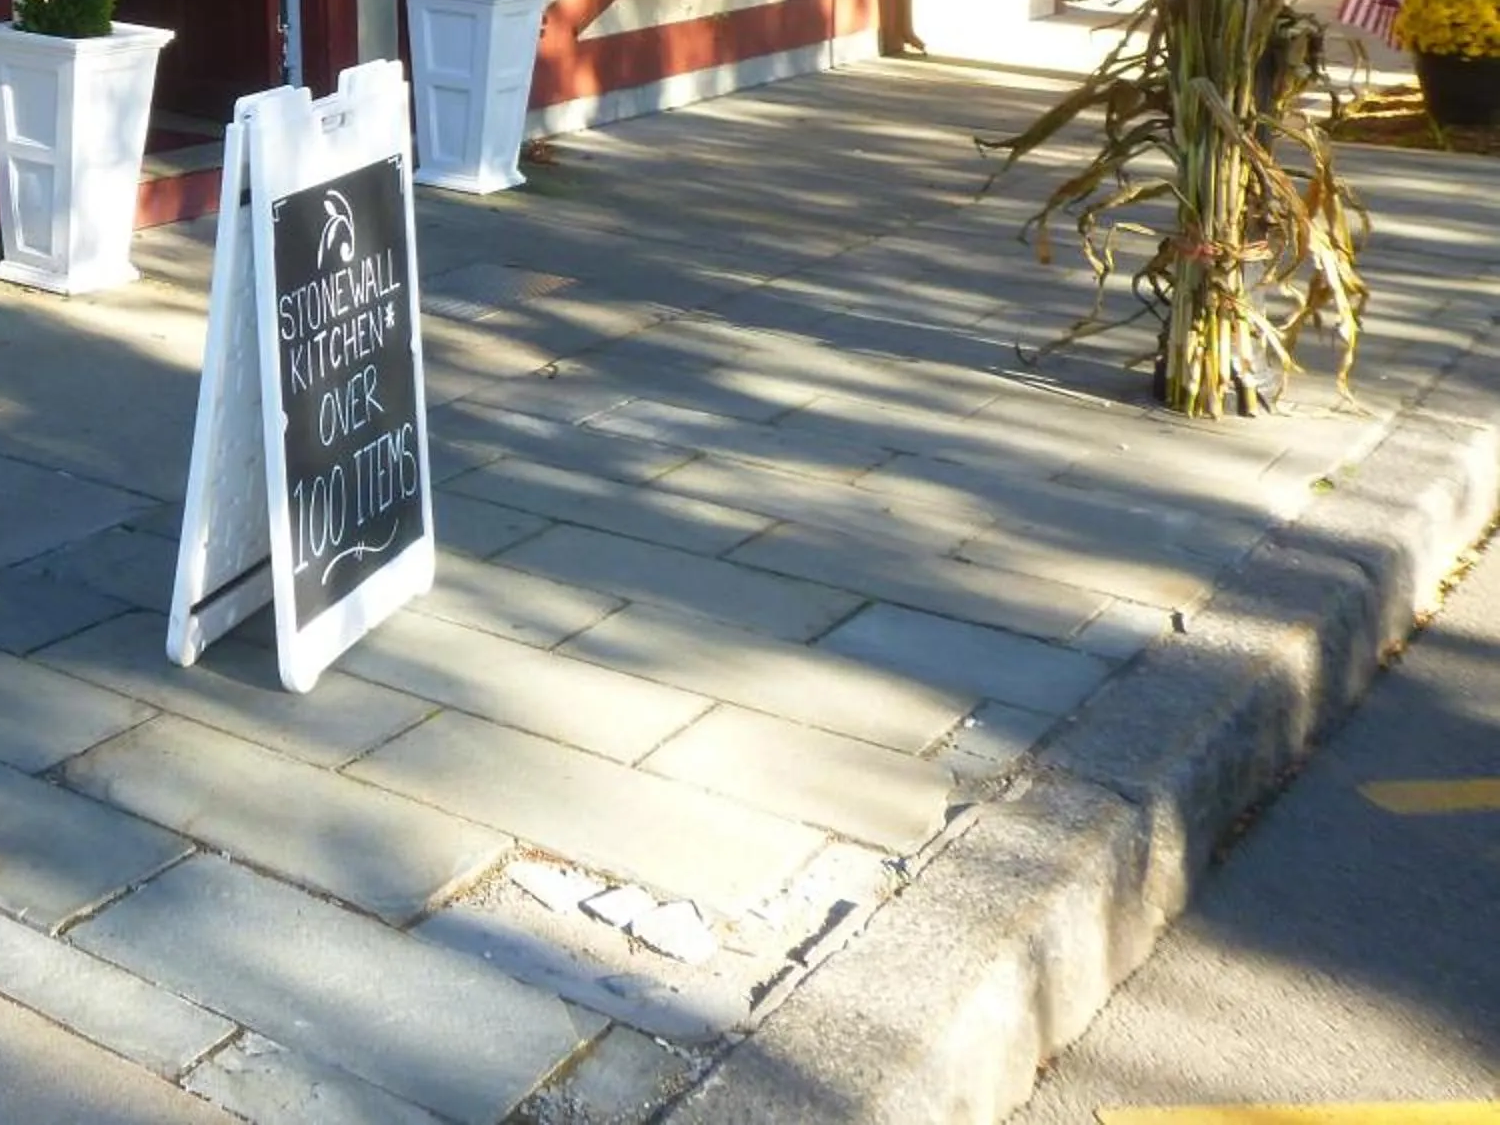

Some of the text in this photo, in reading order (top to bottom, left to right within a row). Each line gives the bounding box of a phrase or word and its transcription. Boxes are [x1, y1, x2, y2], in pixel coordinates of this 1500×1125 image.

[279, 248, 401, 341] STONEWALL
[319, 364, 384, 446] OVER
[294, 423, 418, 574] 100 ITEMS
